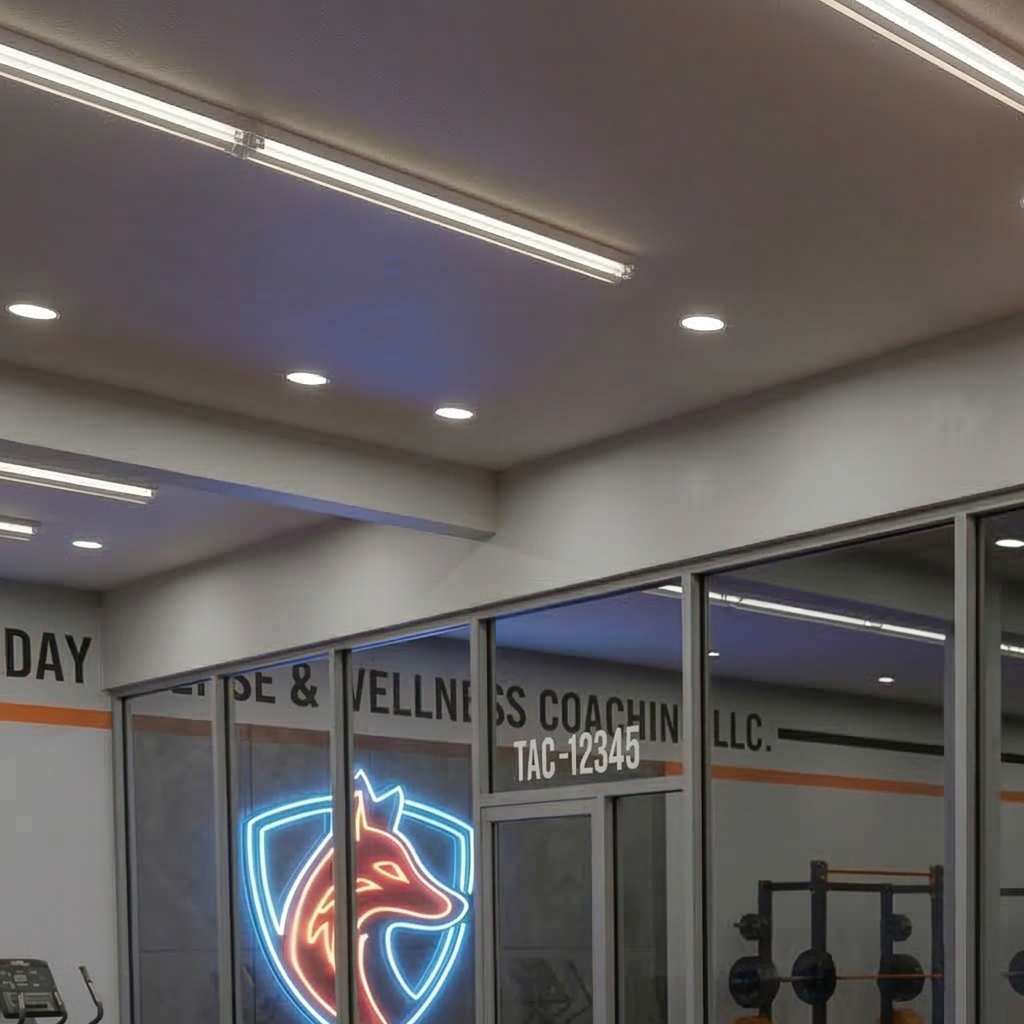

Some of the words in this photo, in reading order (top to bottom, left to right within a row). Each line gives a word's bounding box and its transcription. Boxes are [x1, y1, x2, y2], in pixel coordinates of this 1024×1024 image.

[5, 627, 92, 684] DAY
[291, 663, 319, 708] &
[539, 688, 680, 744] COACHIN
[714, 709, 772, 752] LLC.
[513, 725, 641, 781] TAC-12345
